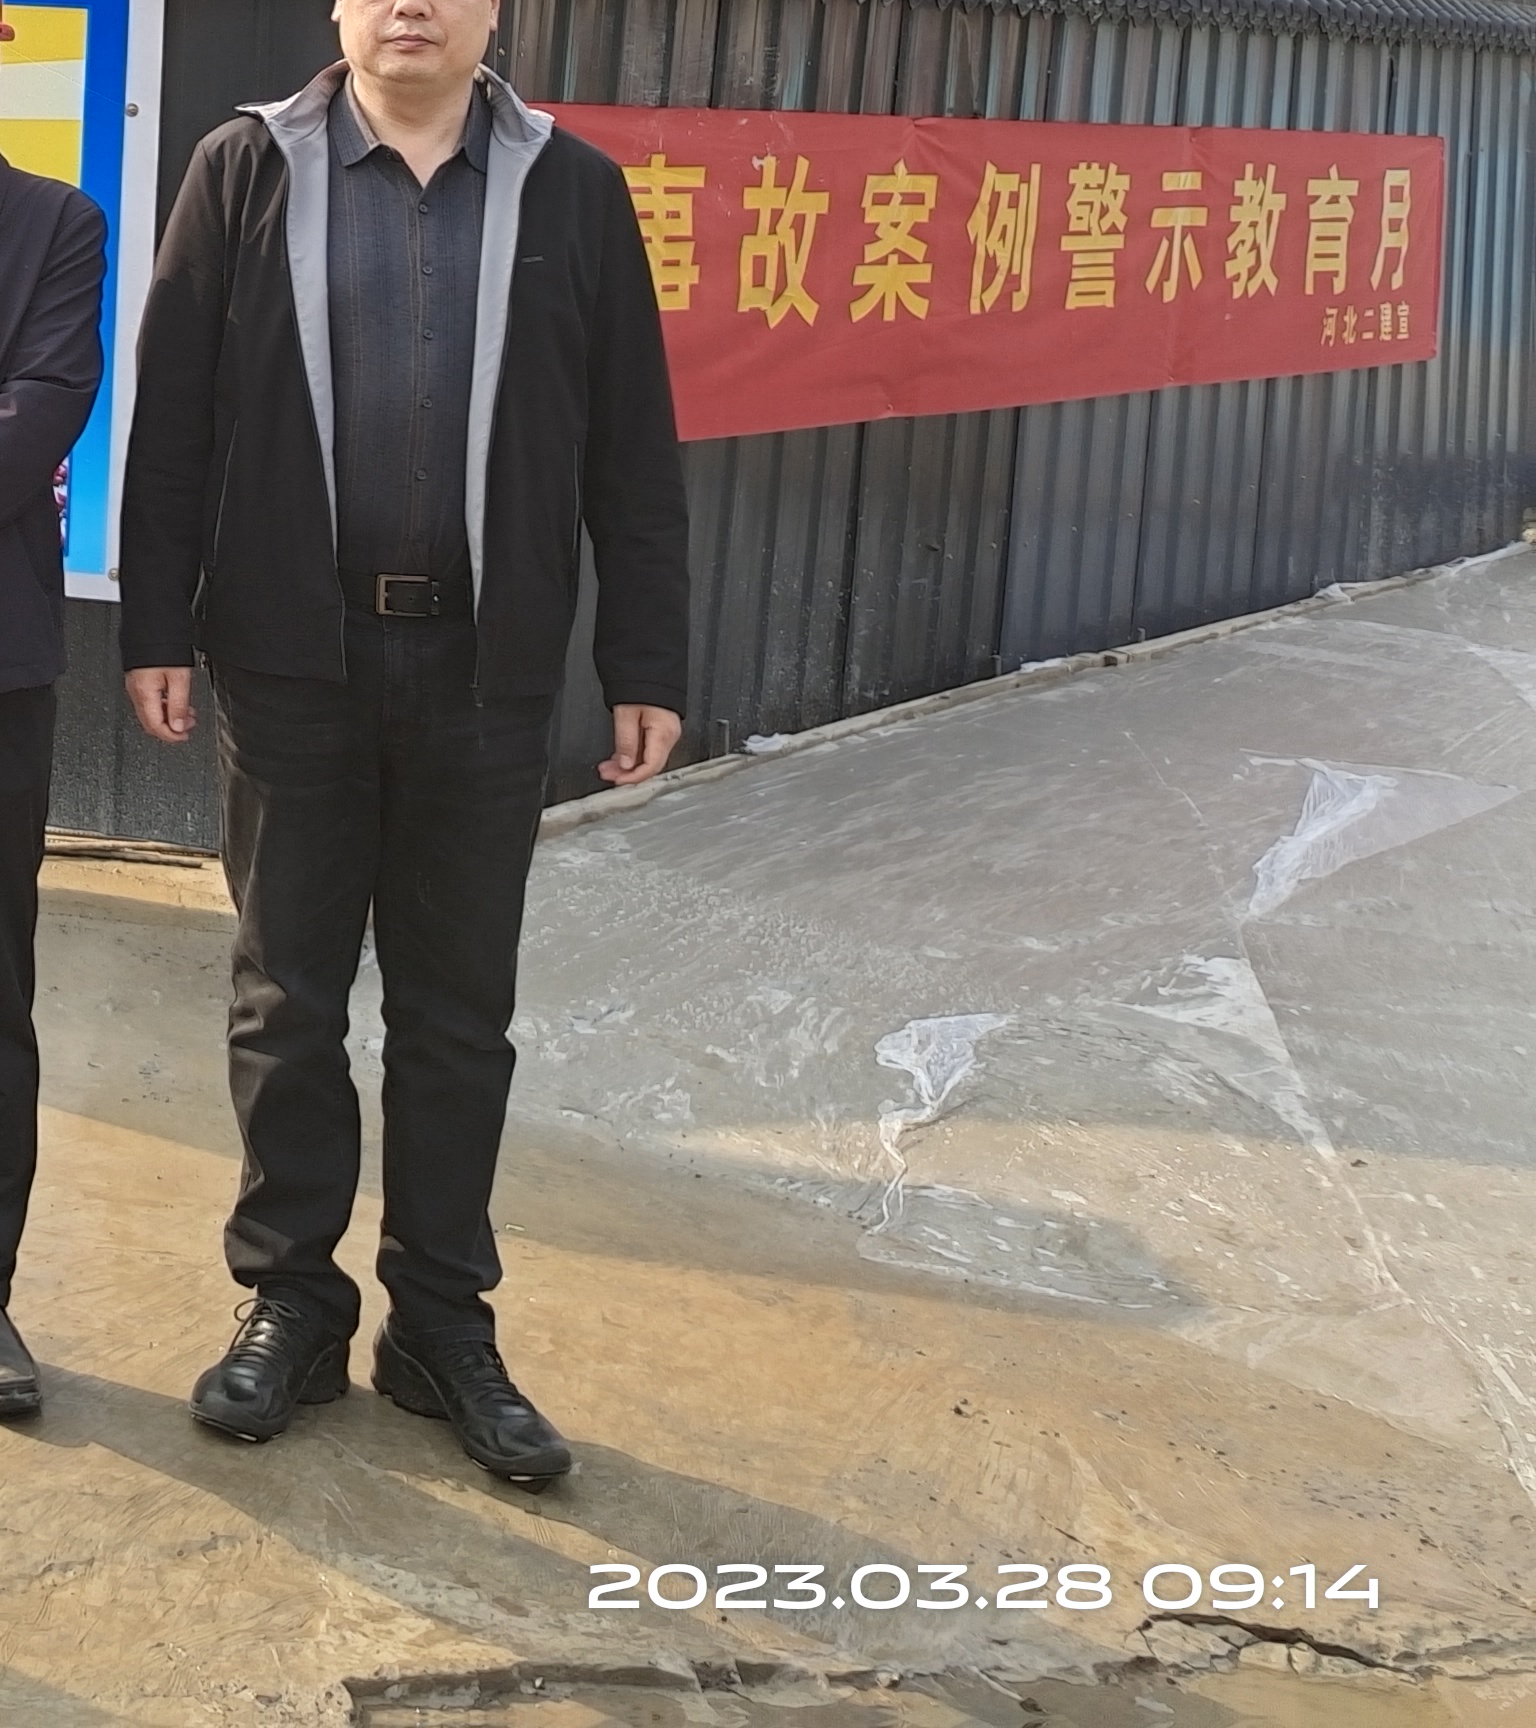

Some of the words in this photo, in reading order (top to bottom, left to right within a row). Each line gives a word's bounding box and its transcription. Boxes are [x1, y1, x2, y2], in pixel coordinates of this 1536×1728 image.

[1320, 300, 1410, 347] 河北二建宣
